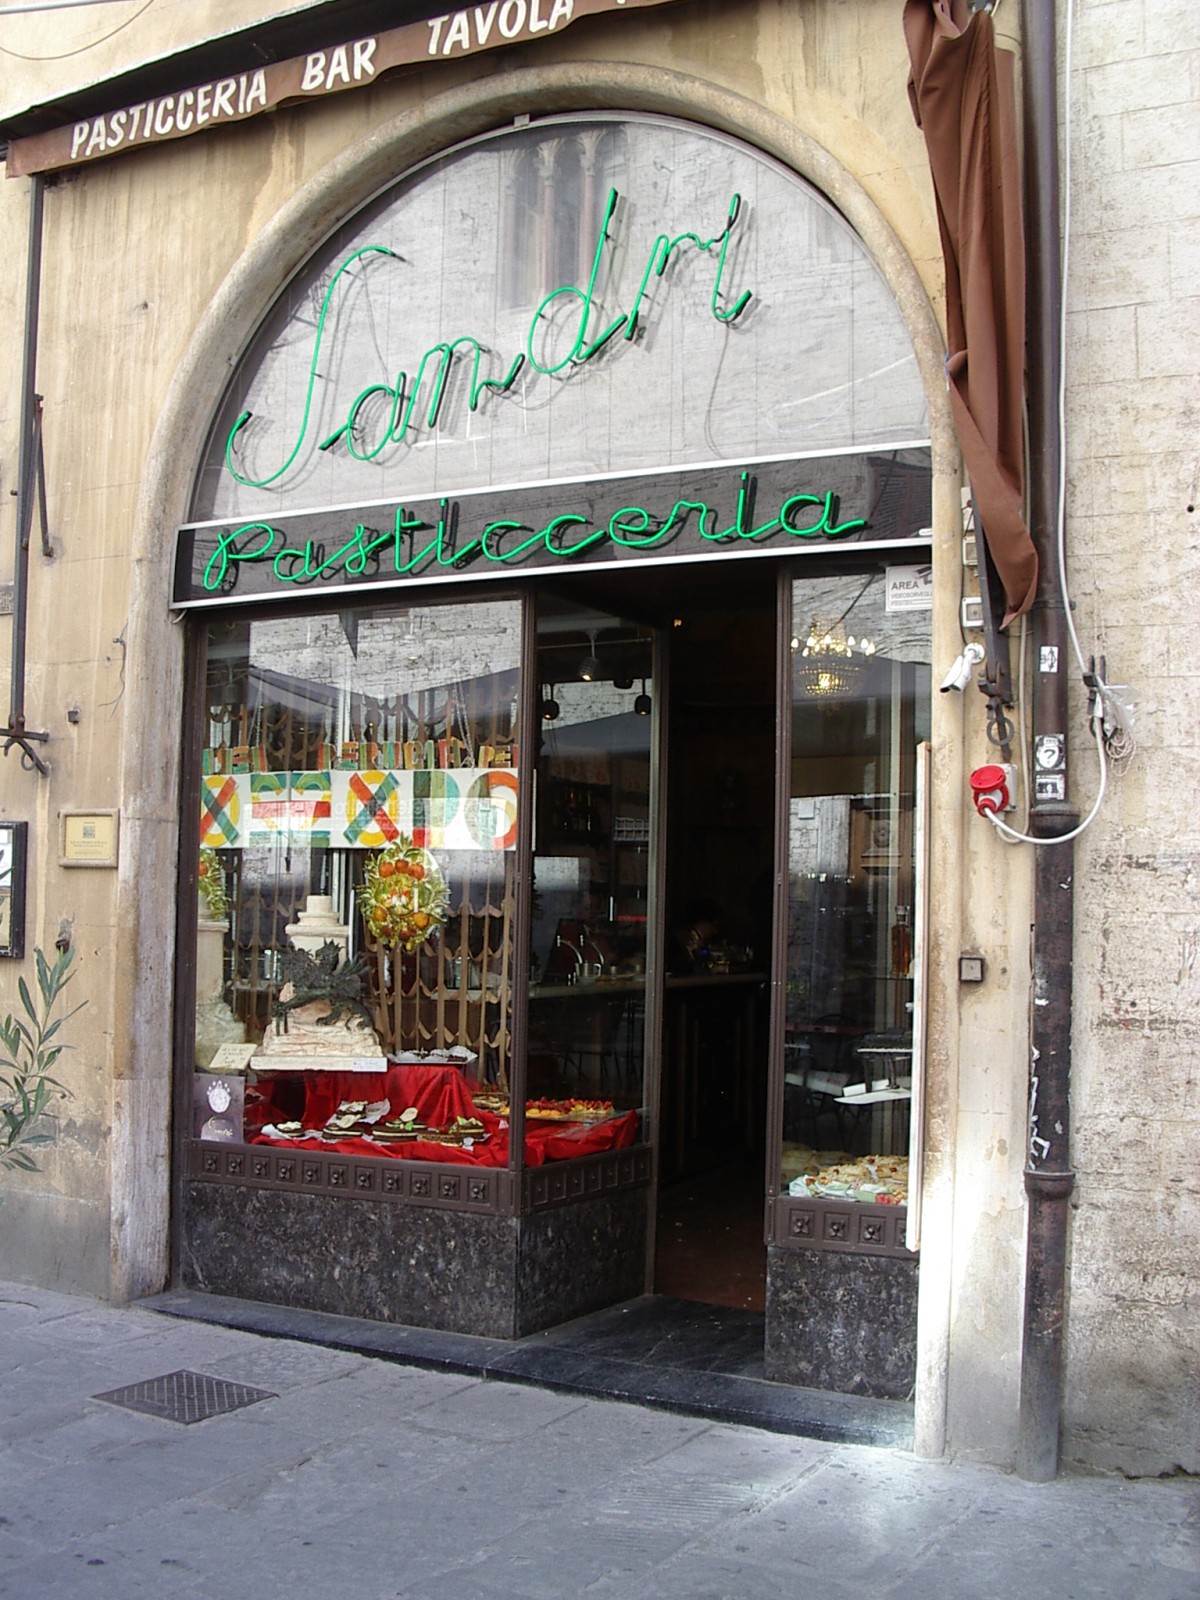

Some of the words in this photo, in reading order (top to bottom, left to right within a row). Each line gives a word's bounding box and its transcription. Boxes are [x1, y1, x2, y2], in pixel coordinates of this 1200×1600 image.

[70, 69, 267, 159] PASTICCERIA
[301, 38, 377, 91] BAR
[428, 0, 573, 55] TAVOLA
[226, 187, 753, 487] Sandri
[891, 581, 919, 590] AREA
